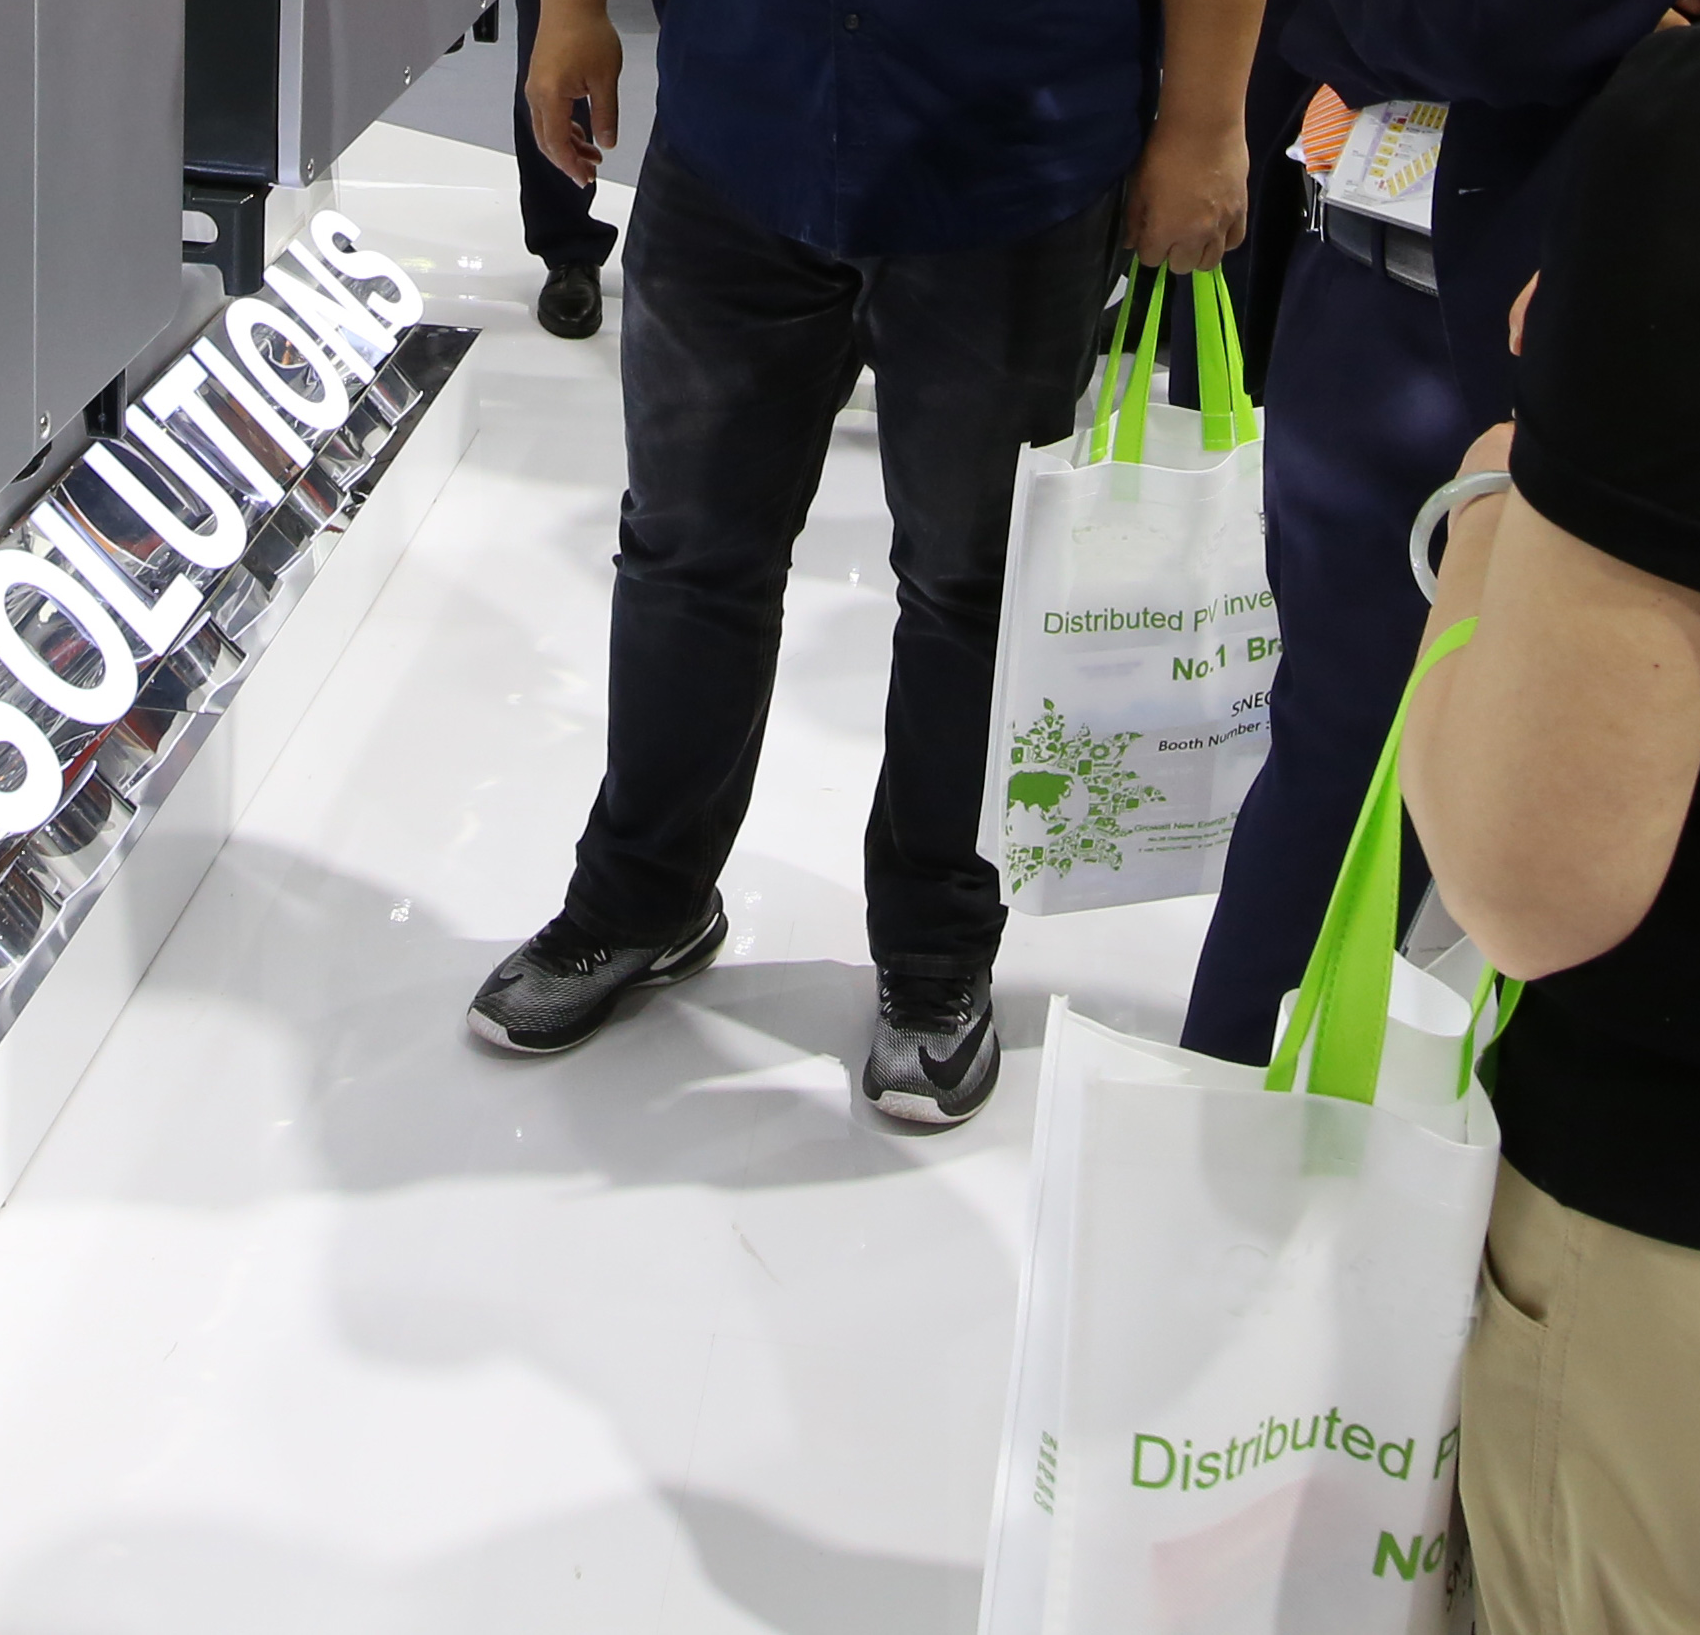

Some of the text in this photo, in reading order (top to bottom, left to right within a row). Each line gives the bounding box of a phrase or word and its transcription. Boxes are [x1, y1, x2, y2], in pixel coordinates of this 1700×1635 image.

[1043, 605, 1184, 635] Distributed
[1194, 598, 1219, 633] PV
[1171, 643, 1227, 682] No.1
[1158, 739, 1204, 753] Booth
[1208, 721, 1262, 749] Number
[1131, 1406, 1415, 1492] Distributed
[1432, 1424, 1461, 1480] P
[1372, 1529, 1446, 1582] No
